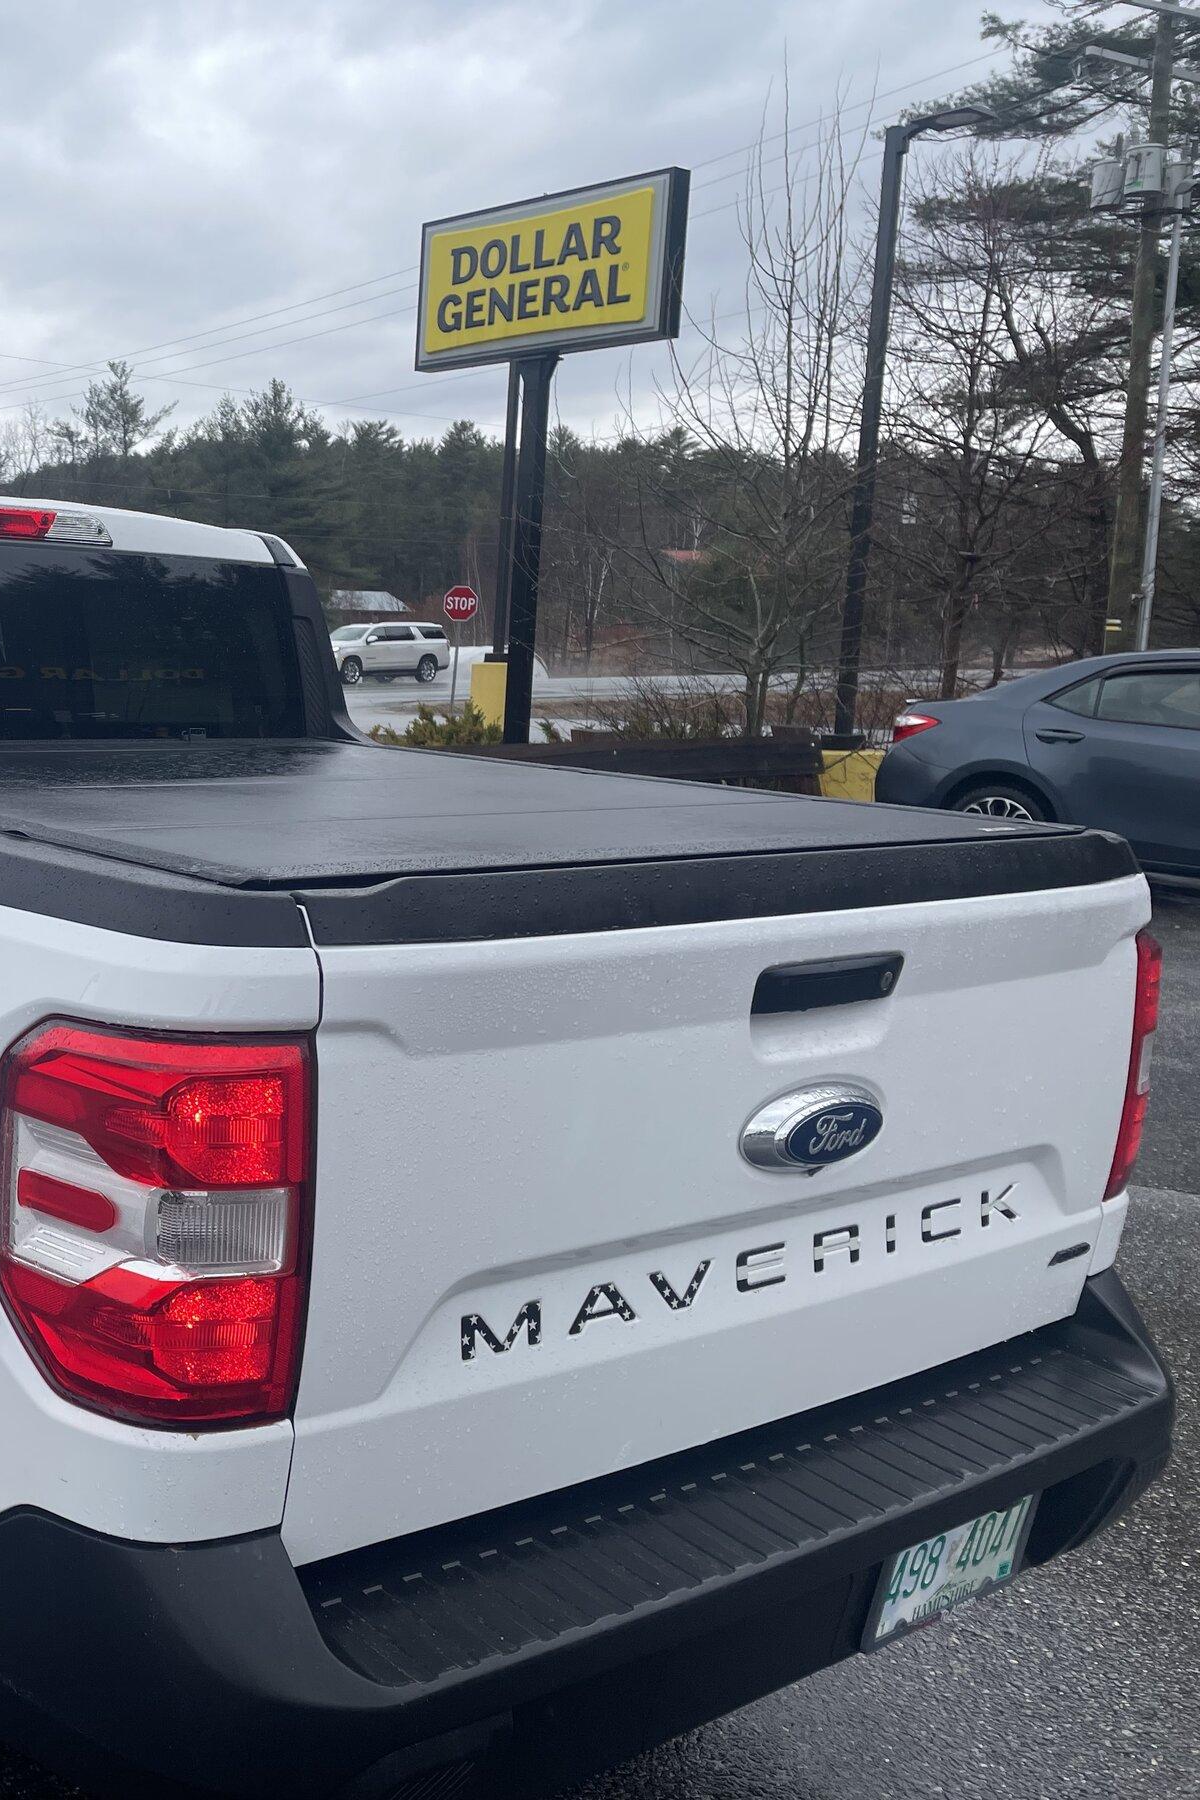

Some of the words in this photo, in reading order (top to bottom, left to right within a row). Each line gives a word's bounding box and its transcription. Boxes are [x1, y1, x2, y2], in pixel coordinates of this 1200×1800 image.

[451, 214, 622, 286] DOLLAR
[437, 264, 631, 333] GENERAL
[446, 597, 475, 610] STOP
[809, 1112, 868, 1155] Ford
[461, 1181, 1022, 1363] MAVERICK
[884, 1534, 946, 1605] 498
